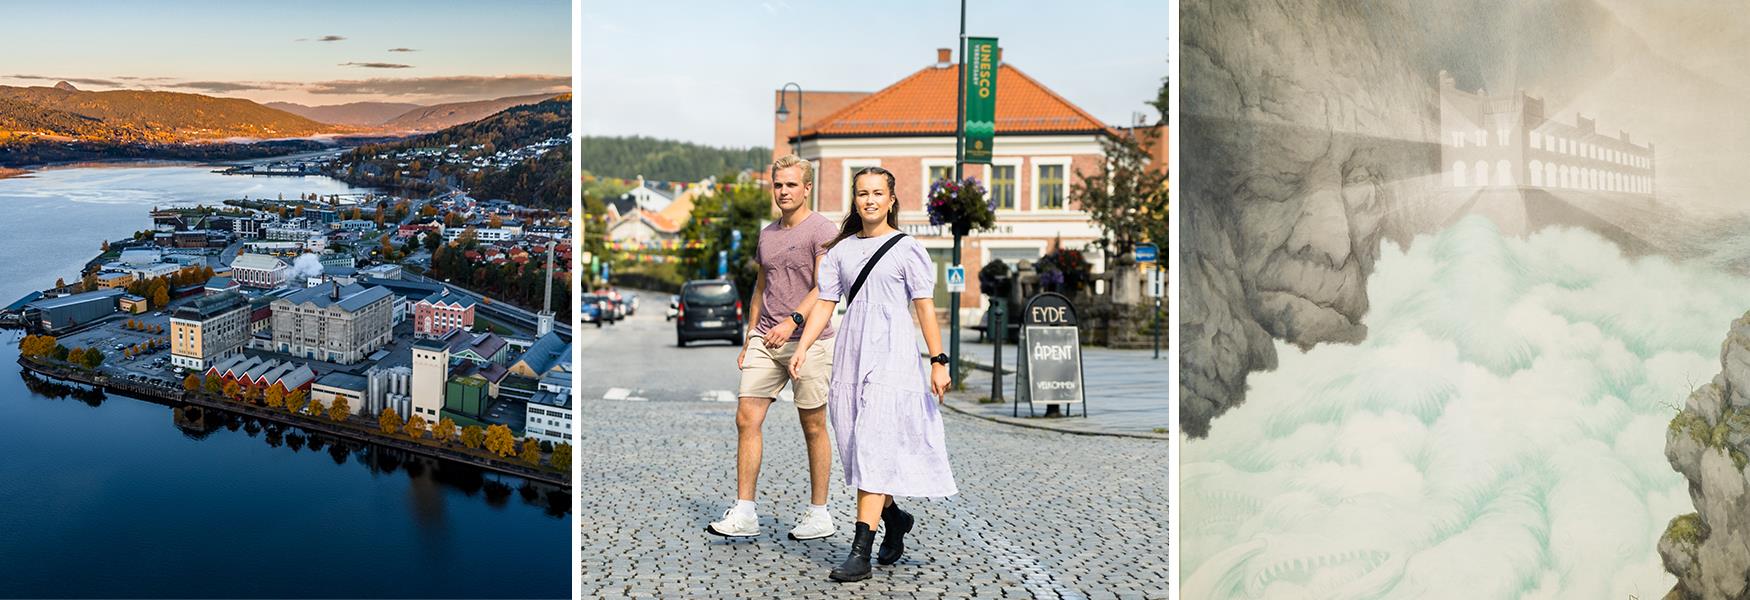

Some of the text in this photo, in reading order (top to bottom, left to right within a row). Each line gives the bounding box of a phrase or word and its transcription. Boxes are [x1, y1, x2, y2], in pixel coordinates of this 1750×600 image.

[979, 44, 992, 98] UNESCO
[1032, 306, 1068, 323] EYDE
[1034, 342, 1073, 361] ÅPENT
